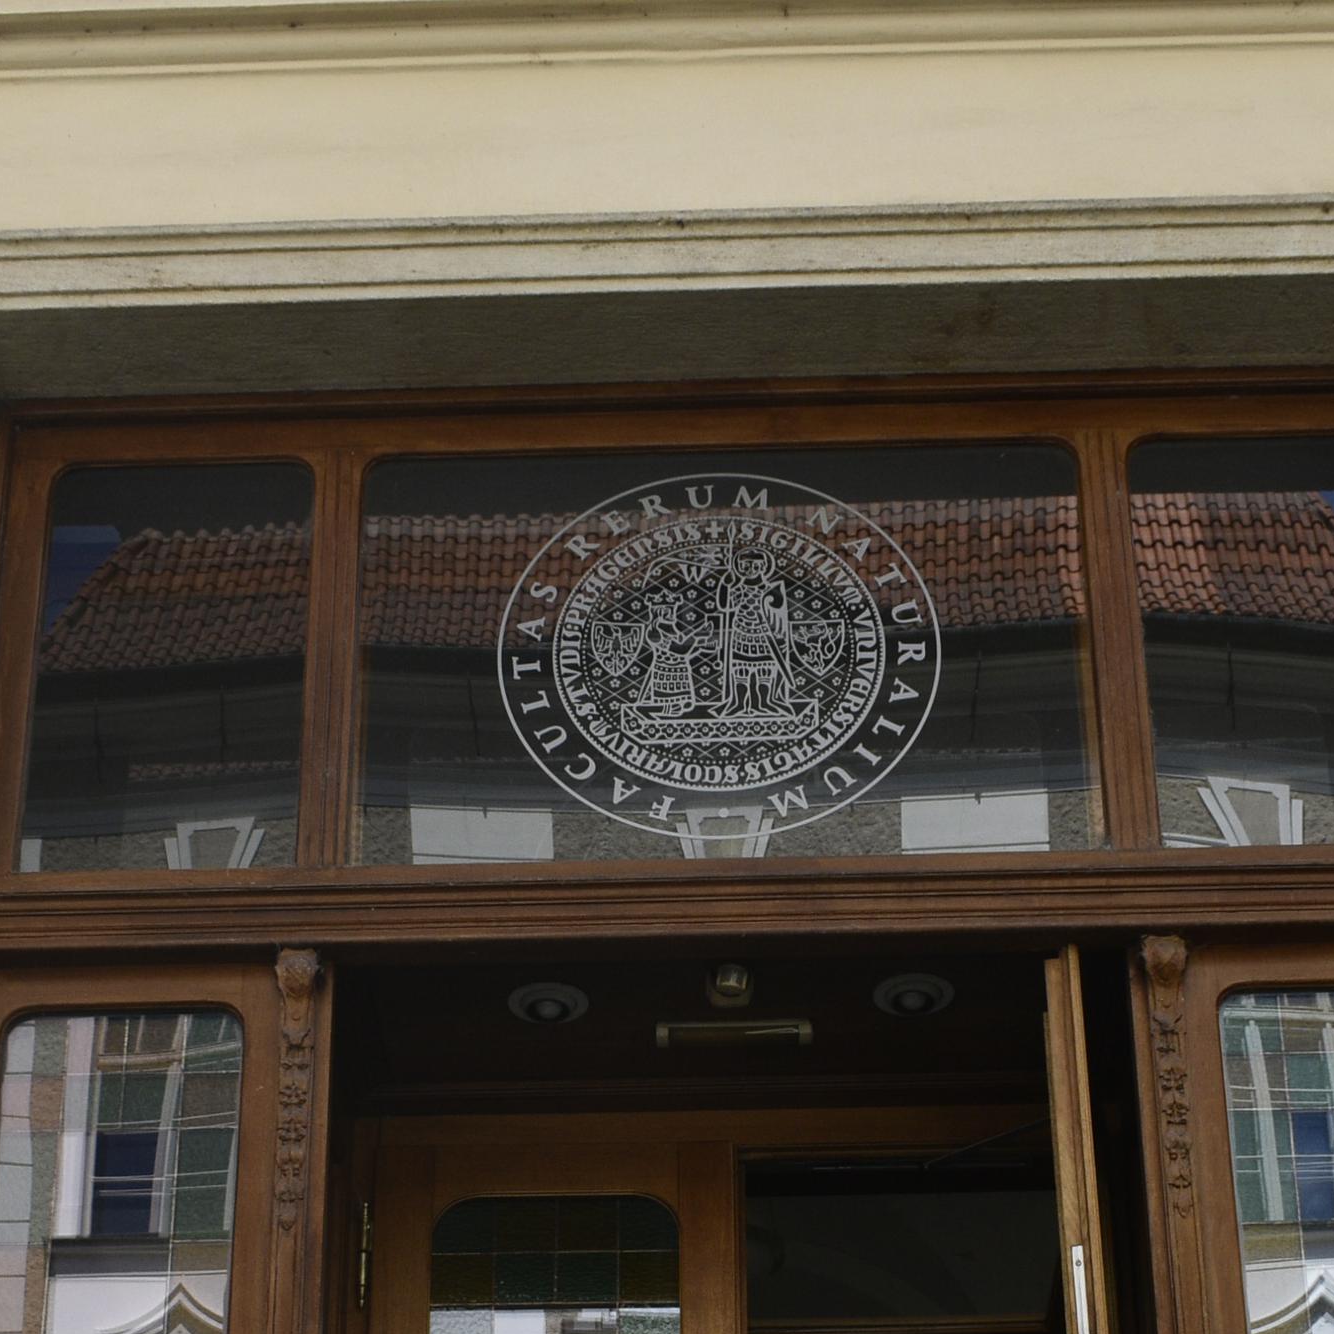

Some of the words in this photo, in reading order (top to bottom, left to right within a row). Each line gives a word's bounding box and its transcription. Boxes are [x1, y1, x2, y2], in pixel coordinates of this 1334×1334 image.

[563, 483, 770, 561] RERUM
[512, 578, 676, 822] FACULTAS
[767, 505, 928, 817] NATURALIUM
